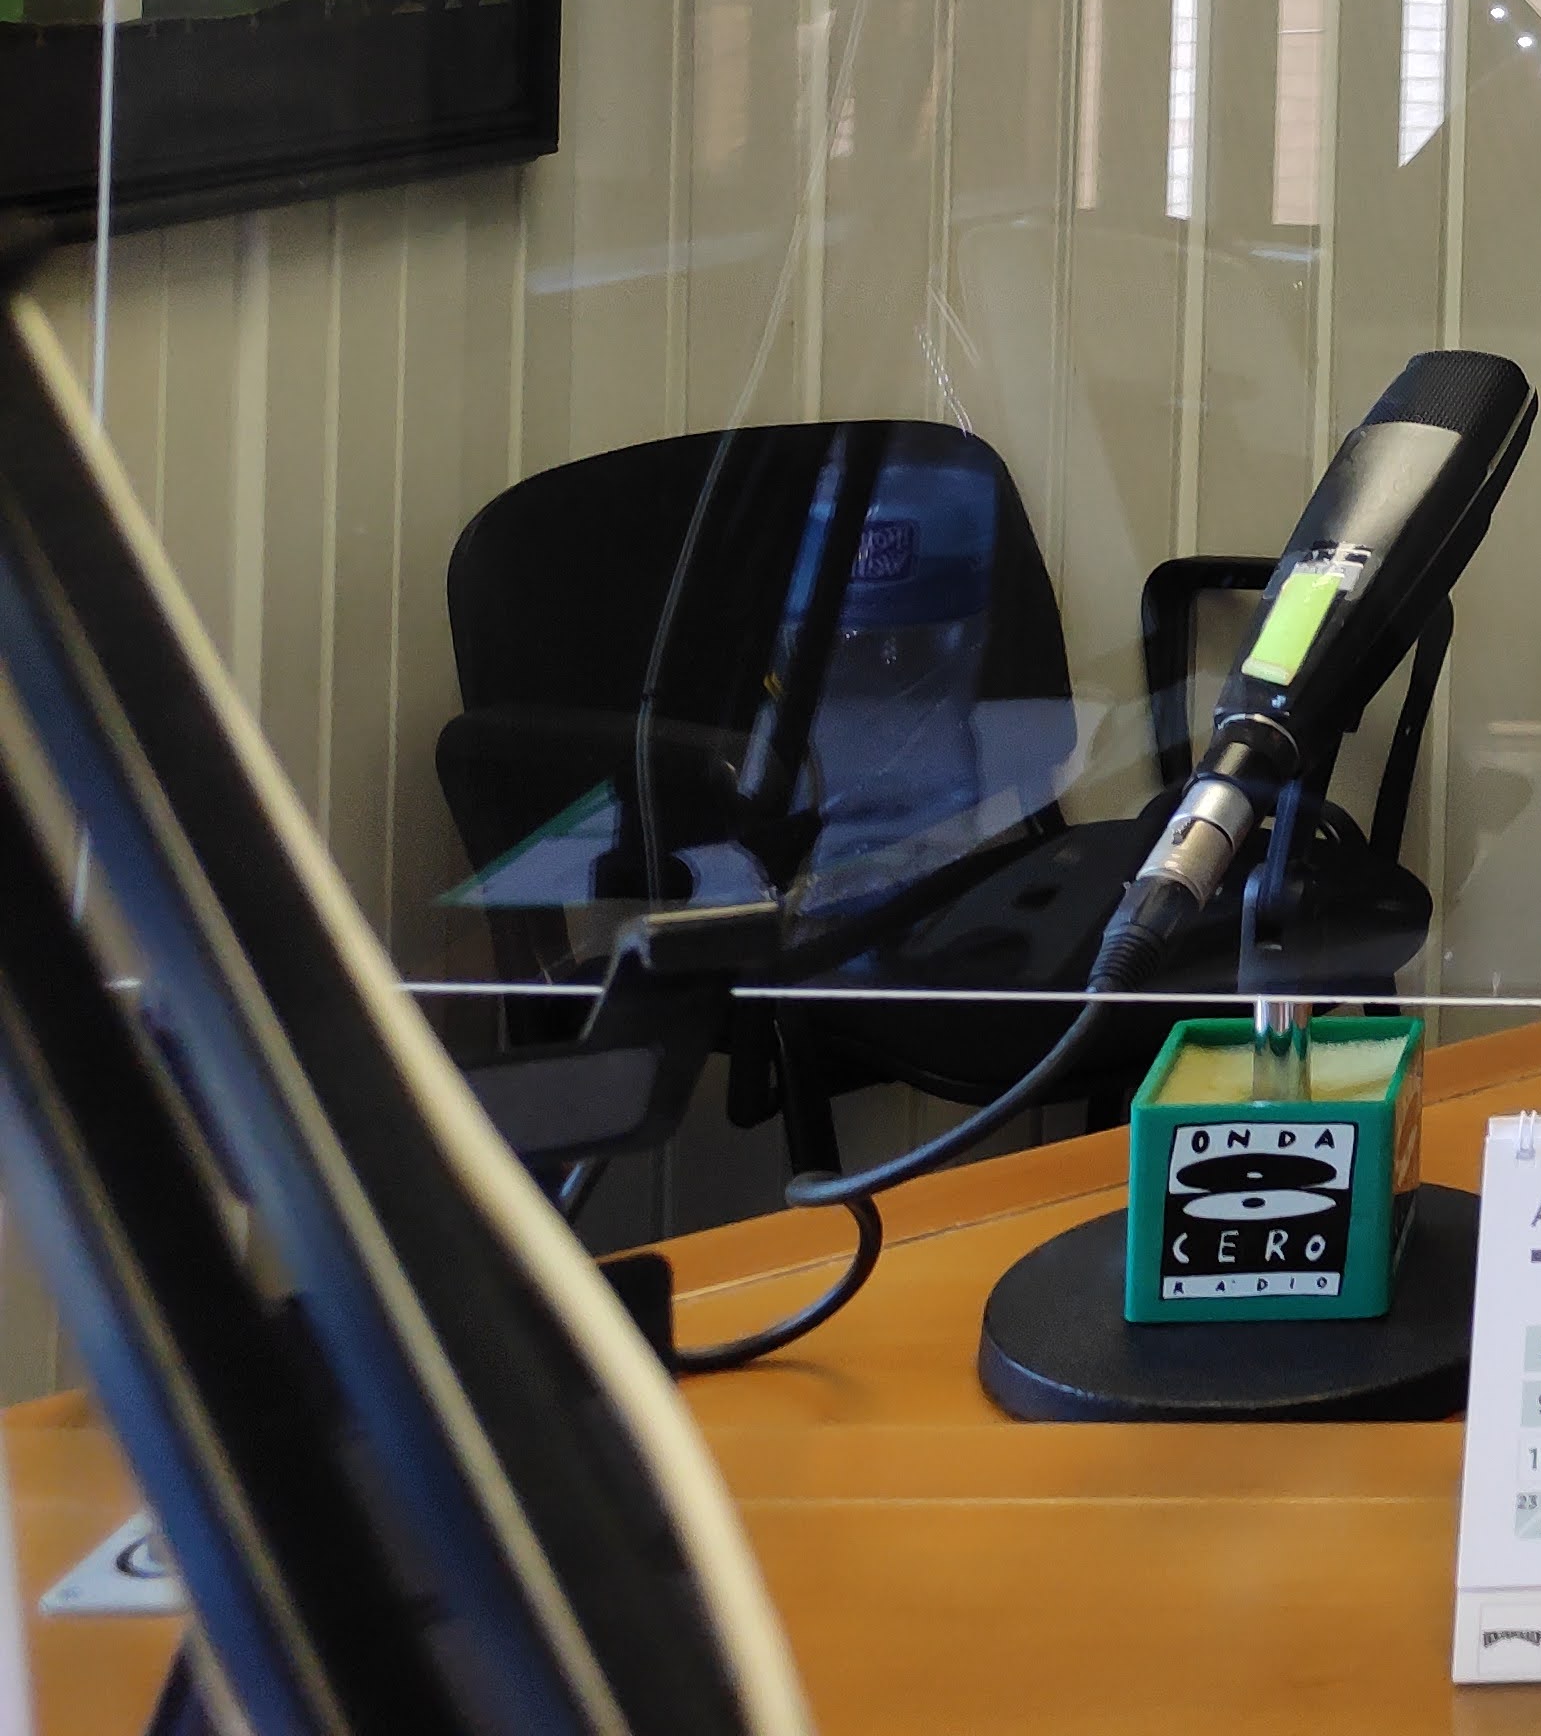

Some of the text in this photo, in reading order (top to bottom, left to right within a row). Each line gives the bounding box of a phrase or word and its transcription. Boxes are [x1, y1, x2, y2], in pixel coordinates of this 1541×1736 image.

[1191, 1129, 1335, 1154] ONDA
[1172, 1229, 1327, 1264] CERO
[1173, 1276, 1327, 1294] RADIO
